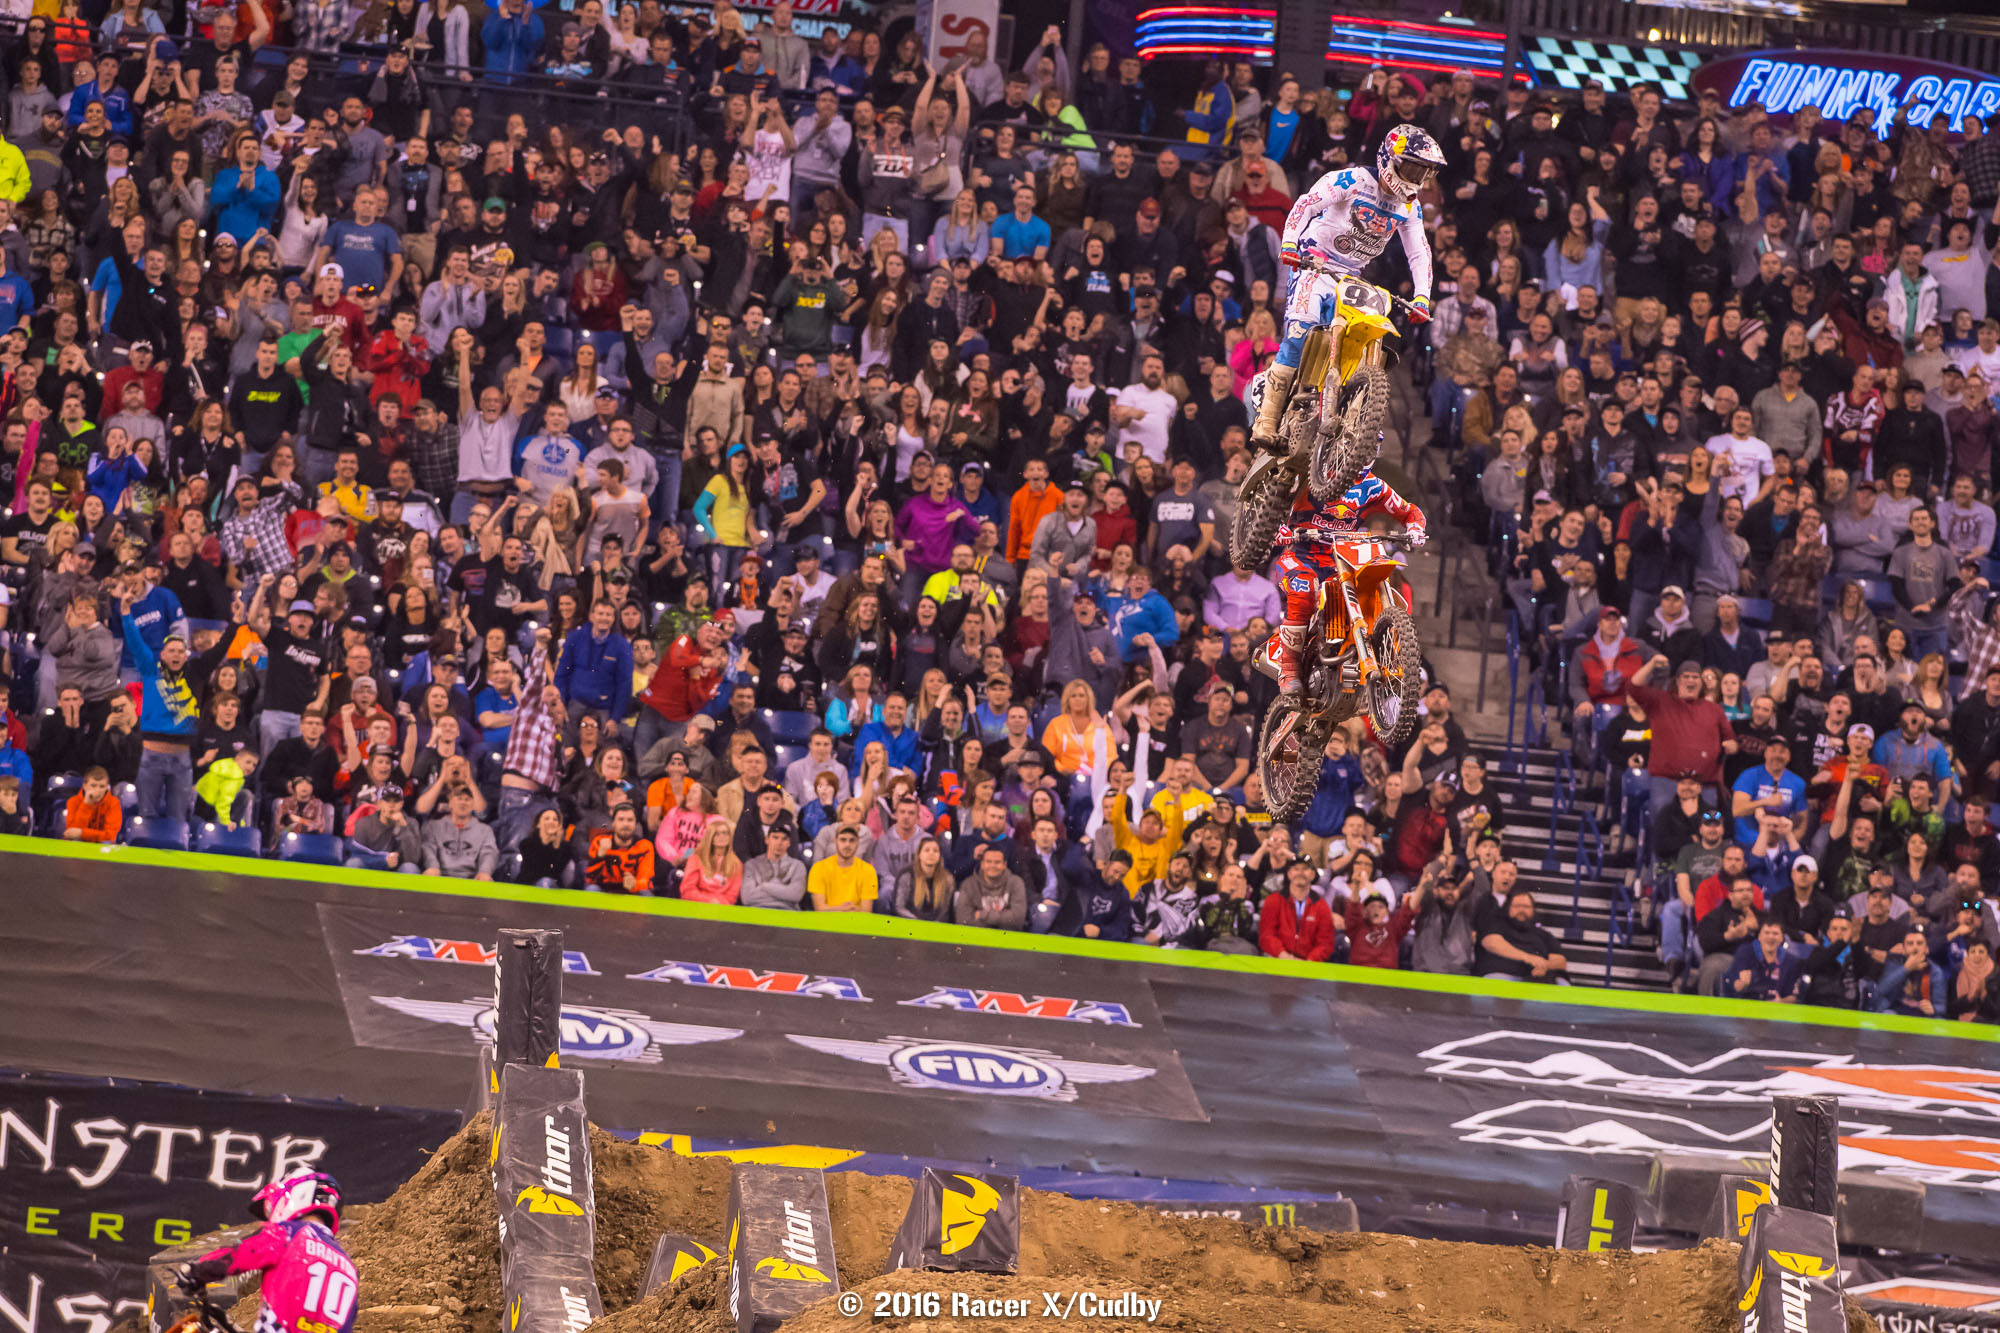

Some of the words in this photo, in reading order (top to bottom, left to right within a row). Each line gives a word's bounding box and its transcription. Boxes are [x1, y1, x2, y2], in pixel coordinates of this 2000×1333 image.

[1311, 513, 1337, 530] Red
[1335, 519, 1358, 531] Bull
[626, 960, 873, 1003] AMA
[897, 985, 1143, 1028] AMA
[918, 1054, 1039, 1085] FIM
[304, 1261, 357, 1326] 10
